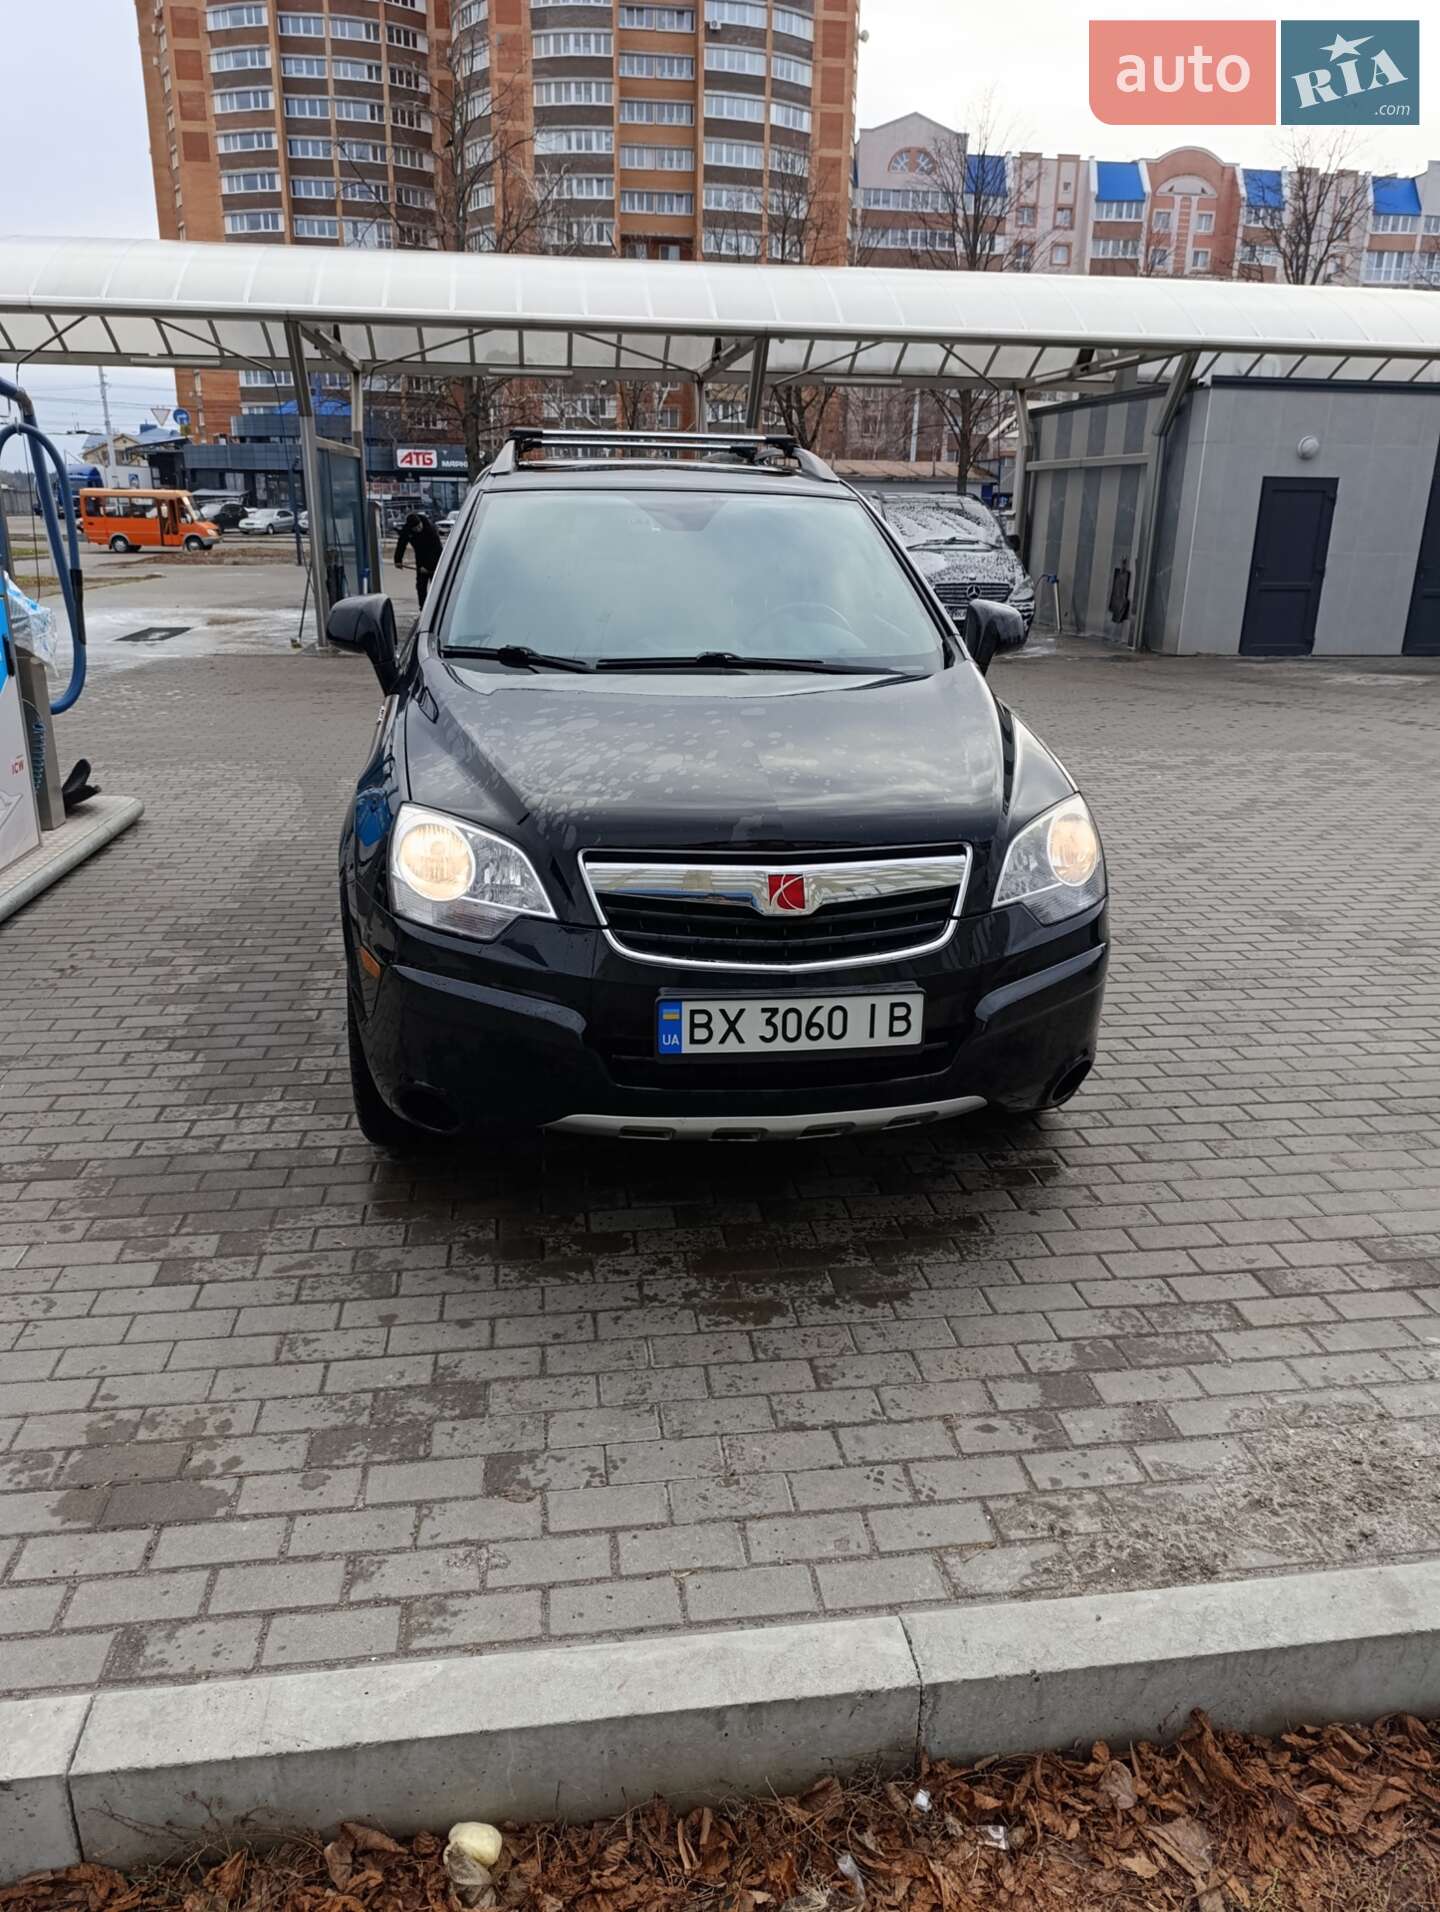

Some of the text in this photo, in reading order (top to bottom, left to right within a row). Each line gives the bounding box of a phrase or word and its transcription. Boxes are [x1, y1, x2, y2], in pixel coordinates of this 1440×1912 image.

[400, 452, 433, 466] АТБ
[688, 1002, 912, 1045] BX 3060 IB
[662, 1033, 680, 1046] UA
